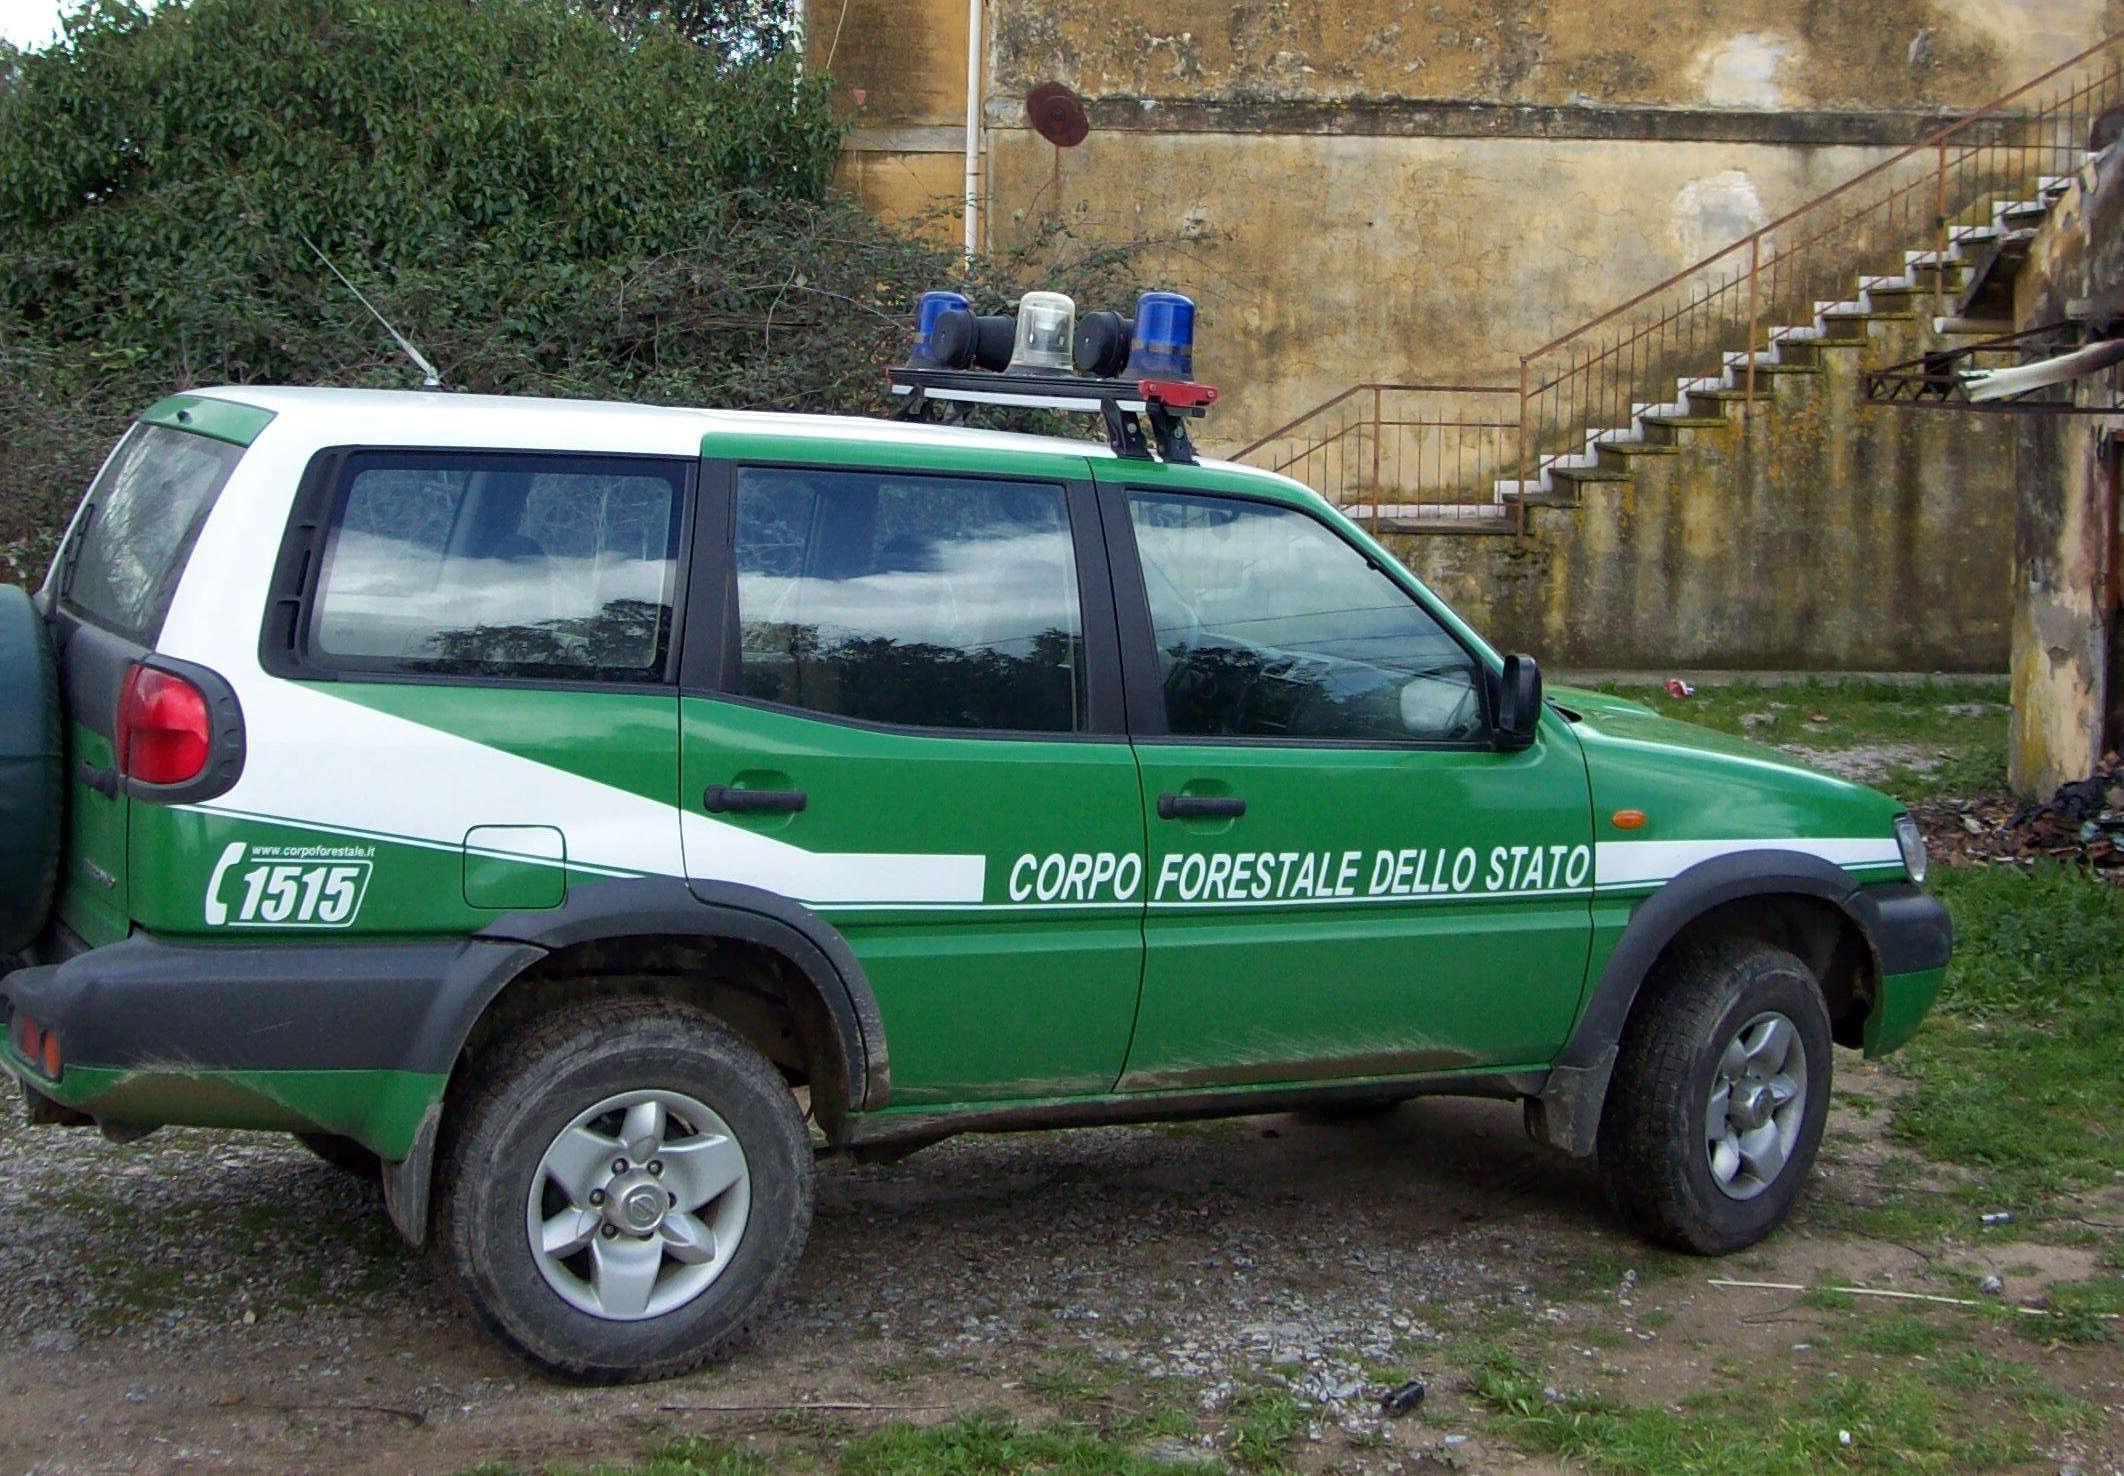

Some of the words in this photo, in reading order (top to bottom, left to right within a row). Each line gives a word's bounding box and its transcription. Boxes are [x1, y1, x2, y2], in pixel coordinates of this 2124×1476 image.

[252, 845, 376, 858] www.corpoforestale.it
[1009, 852, 1142, 902] CORPO
[1155, 851, 1362, 900] FORESTALE
[1368, 847, 1477, 895] DELLO
[1485, 844, 1590, 891] STATO
[239, 866, 361, 922] 1515
